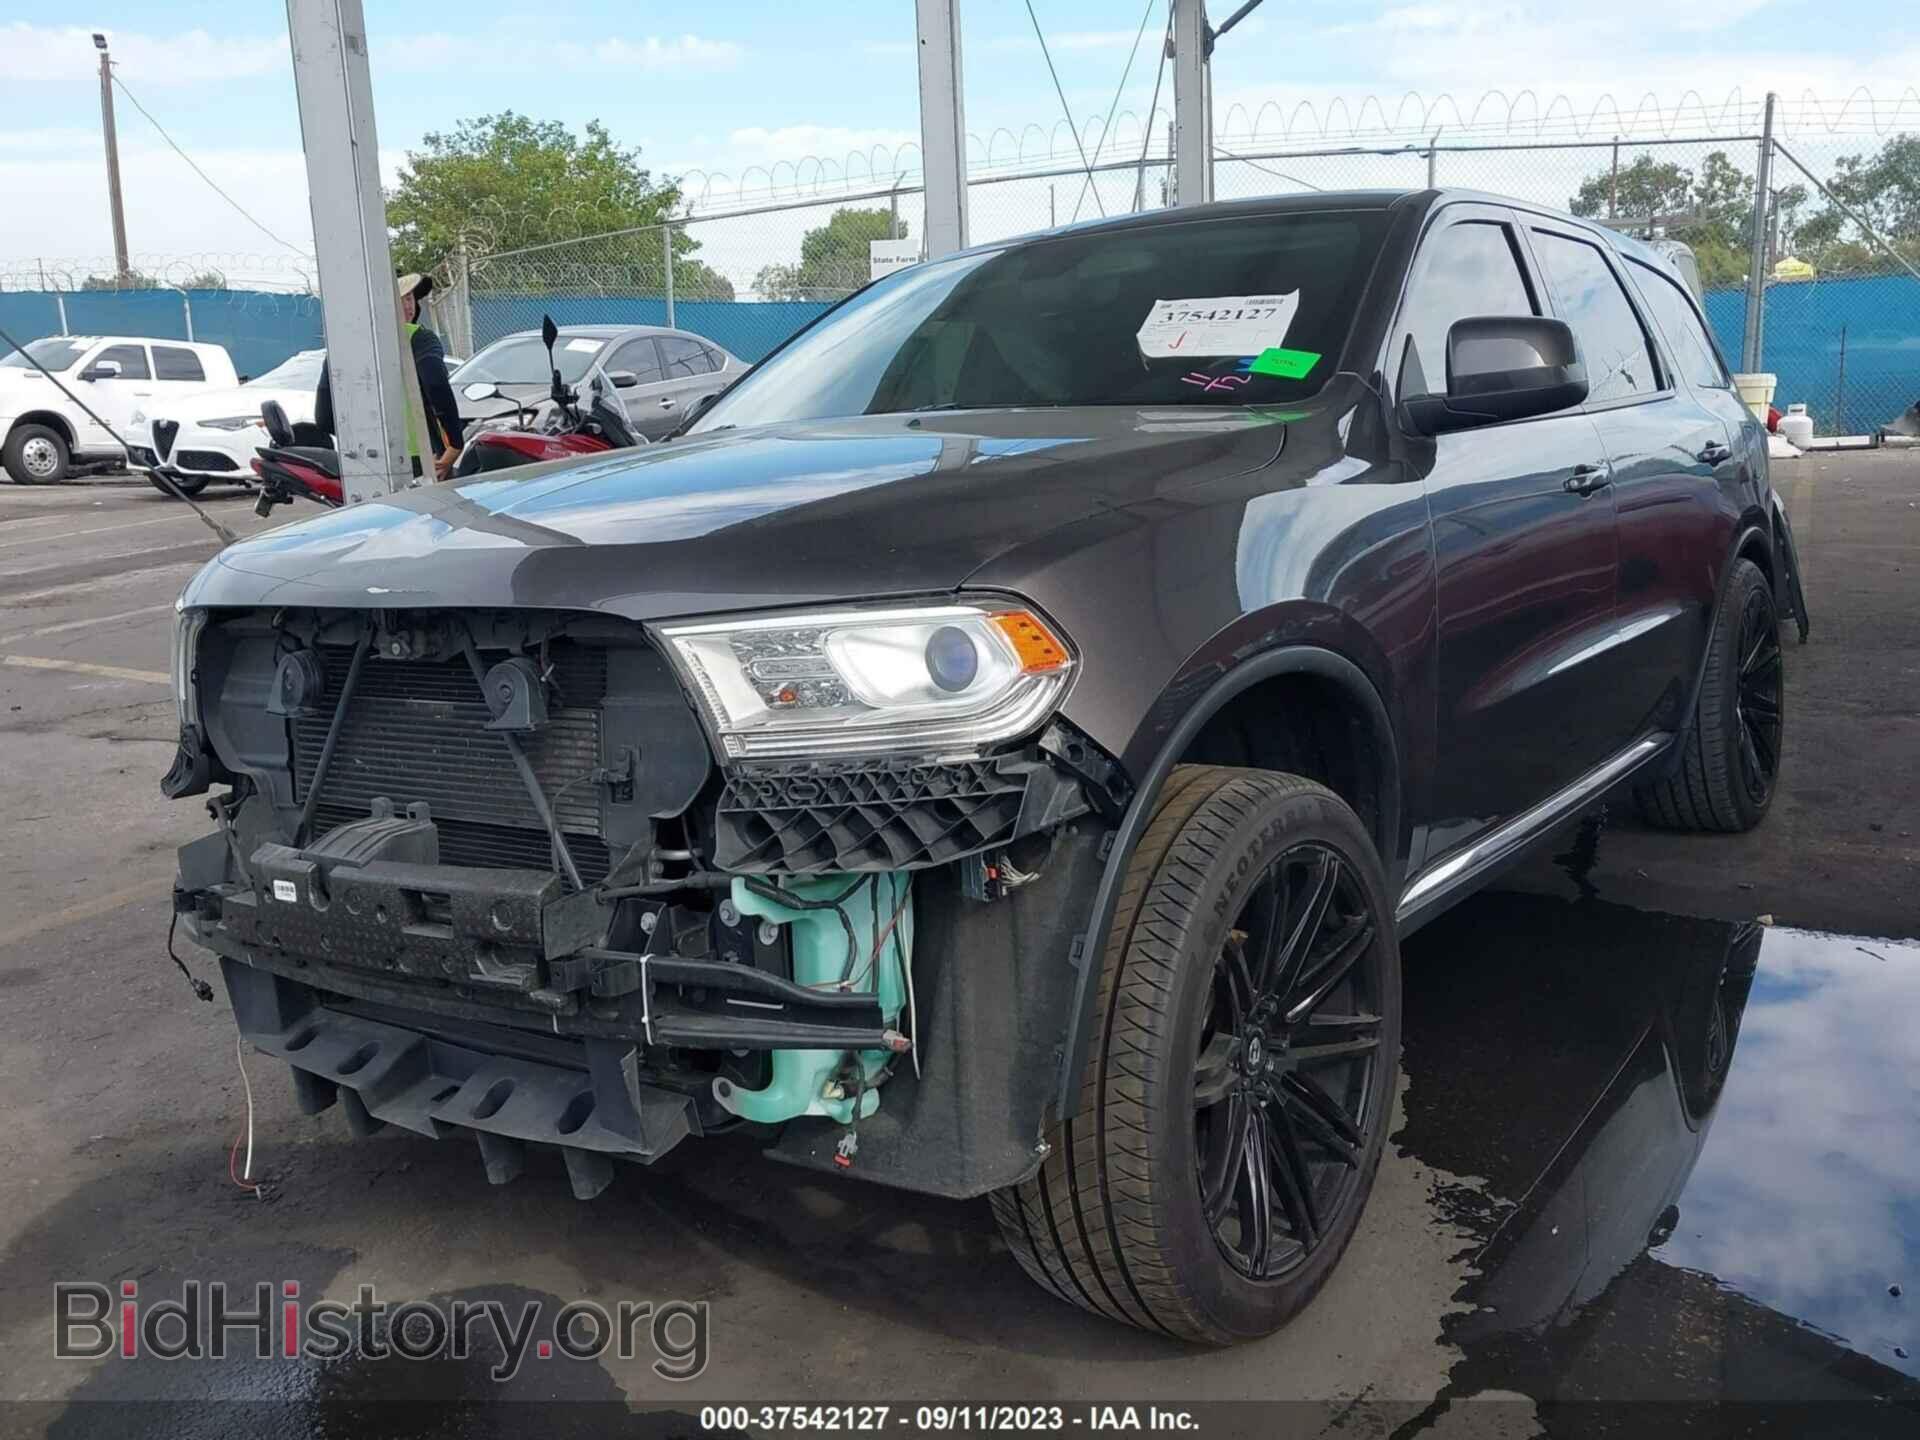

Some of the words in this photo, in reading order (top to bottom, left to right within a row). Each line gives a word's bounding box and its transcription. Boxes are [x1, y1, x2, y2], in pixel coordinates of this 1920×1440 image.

[872, 256, 893, 264] State
[895, 255, 917, 263] Farm
[1159, 308, 1277, 323] 37542127
